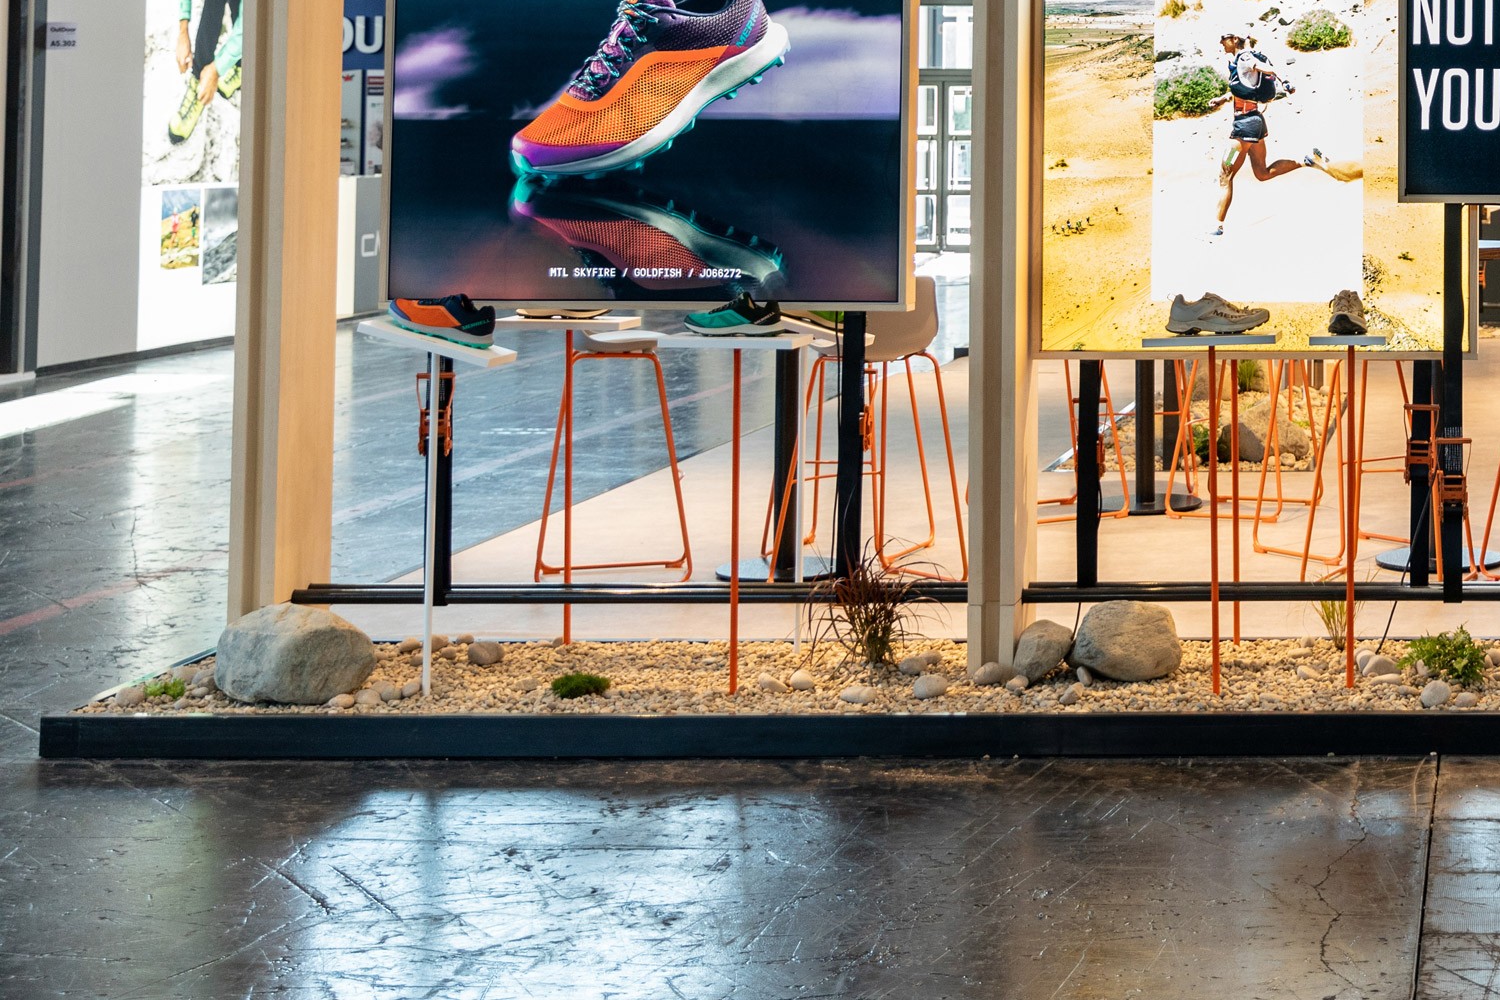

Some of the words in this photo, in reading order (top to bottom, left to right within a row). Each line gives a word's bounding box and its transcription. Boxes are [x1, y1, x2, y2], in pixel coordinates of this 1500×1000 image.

[1412, 68, 1500, 131] YOU
[549, 267, 568, 278] MTL
[573, 267, 616, 278] SKYFIRE
[633, 267, 682, 278] GOLDFISH
